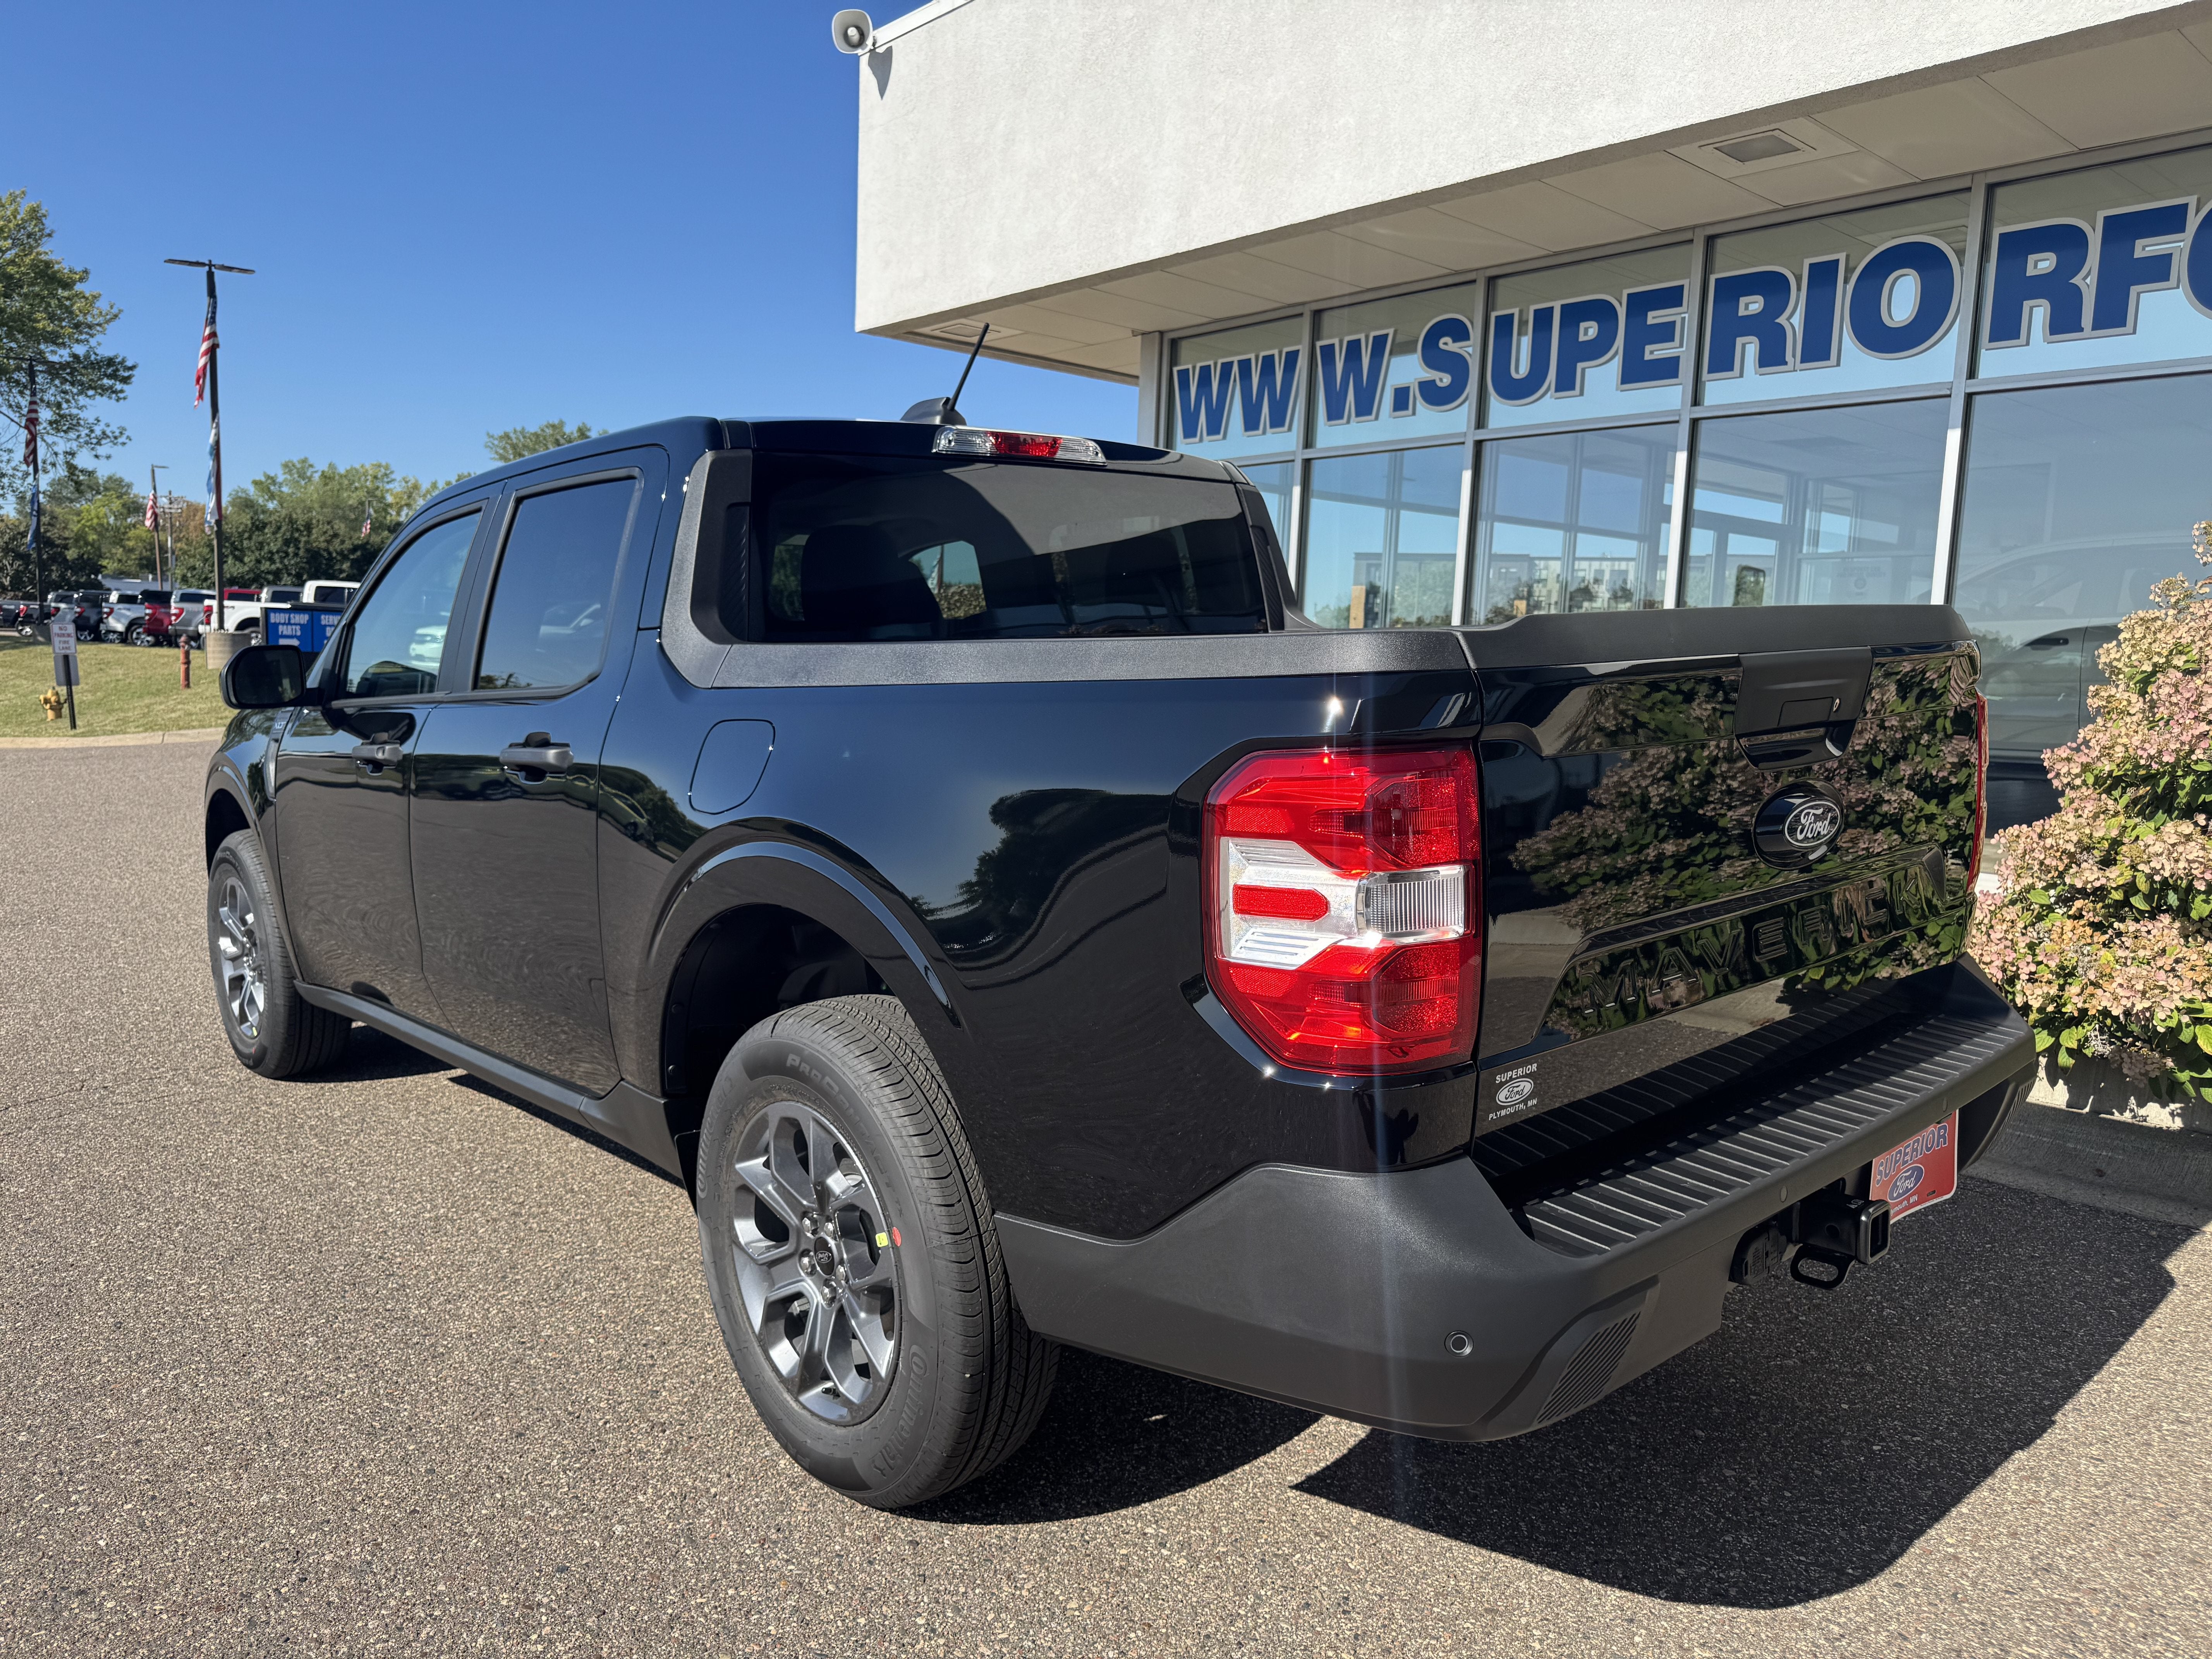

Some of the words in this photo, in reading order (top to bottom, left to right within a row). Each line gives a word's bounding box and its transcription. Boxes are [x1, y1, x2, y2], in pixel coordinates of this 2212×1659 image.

[1172, 195, 2212, 444] WWW.SUPERIORF
[270, 612, 289, 623] BODY
[290, 613, 309, 625] SHOP
[320, 615, 341, 625] SERV
[278, 625, 301, 635] PARTS
[1797, 808, 1830, 840] Ford
[1579, 873, 1922, 1015] MAVERICK
[1496, 1063, 1537, 1083] SUPERIOR
[1505, 1084, 1525, 1100] Ford
[1489, 1103, 1526, 1120] PLYMOUTH,
[1527, 1098, 1537, 1107] MN
[1875, 1123, 1948, 1187] SUPERIOR
[1894, 1170, 1917, 1197] Ford
[1890, 1200, 1908, 1217] ymouth,
[1910, 1194, 1918, 1204] MN
